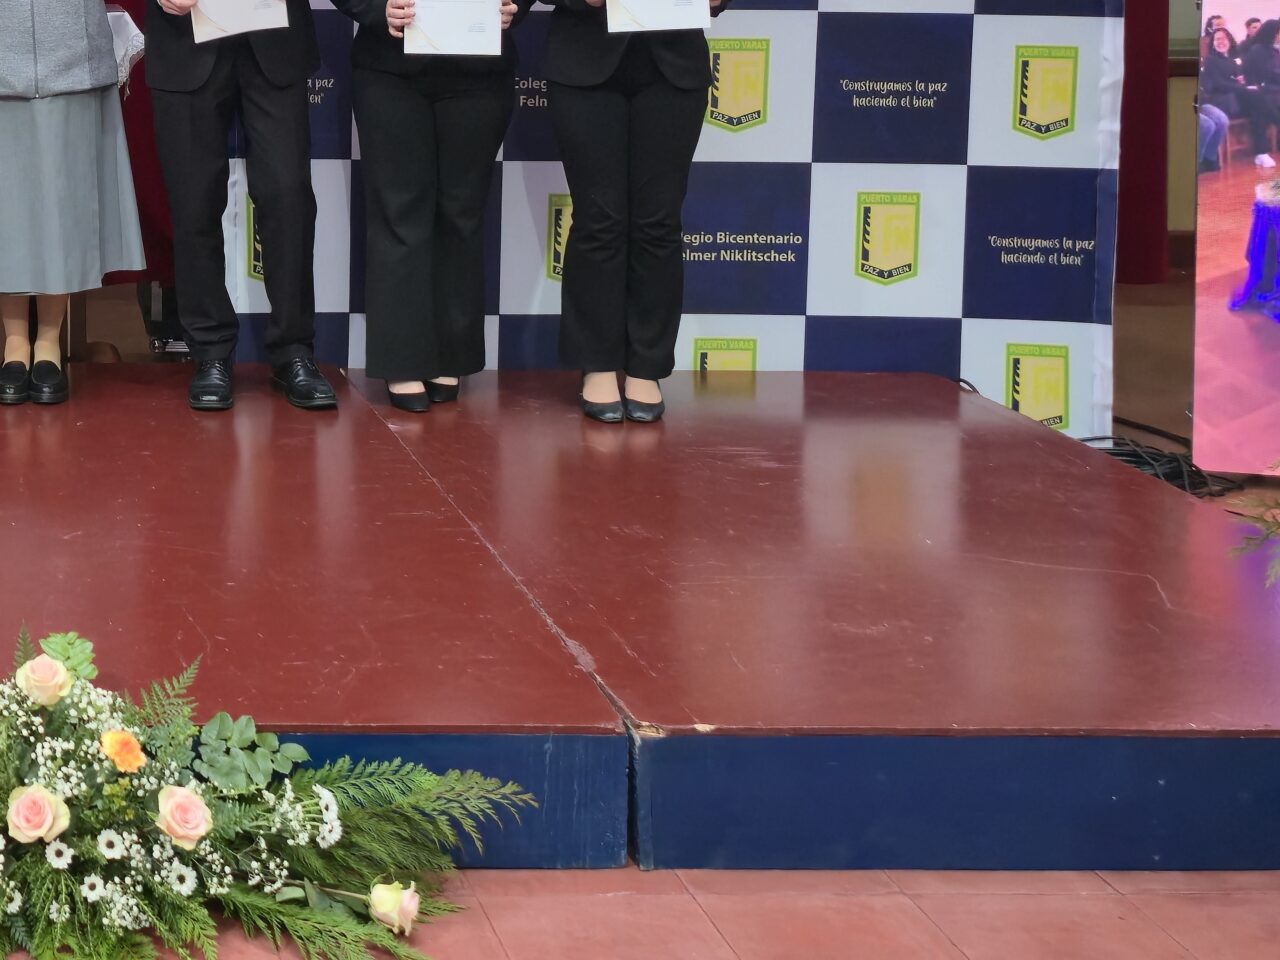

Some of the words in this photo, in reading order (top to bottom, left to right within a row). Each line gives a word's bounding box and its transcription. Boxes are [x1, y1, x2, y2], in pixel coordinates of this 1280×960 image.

[315, 78, 334, 90] paz
[915, 80, 925, 92] la
[928, 82, 947, 94] paz
[853, 95, 898, 107] haciendo
[901, 95, 910, 107] el
[716, 232, 802, 244] Bicentenario
[1063, 237, 1073, 249] la
[1075, 239, 1095, 251] paz
[720, 250, 796, 261] Niklitschek
[1001, 251, 1046, 264] haciendo
[1048, 252, 1058, 264] el
